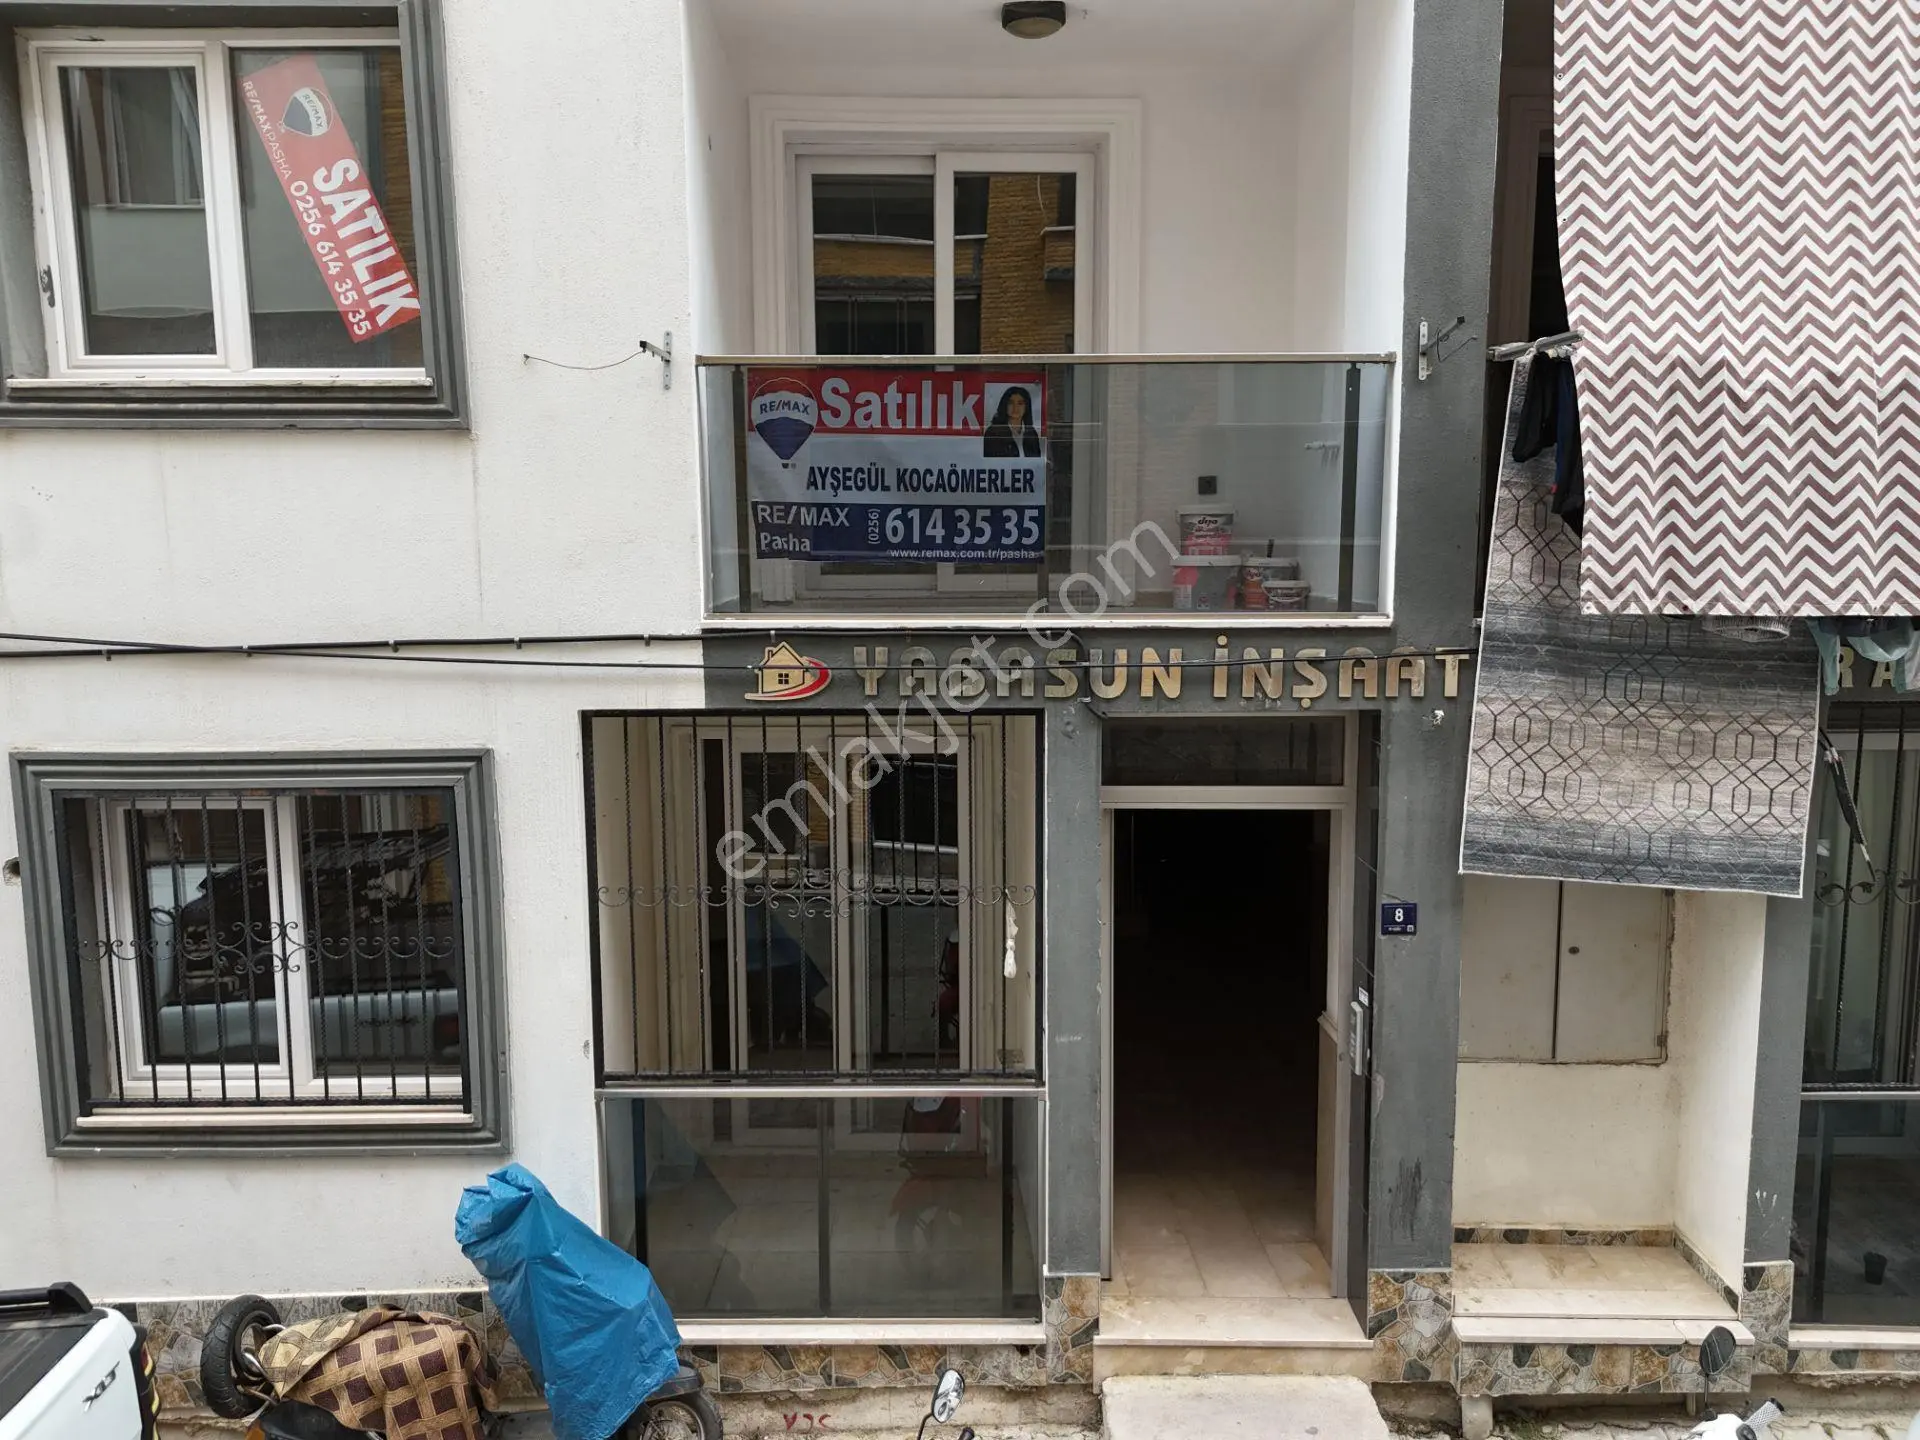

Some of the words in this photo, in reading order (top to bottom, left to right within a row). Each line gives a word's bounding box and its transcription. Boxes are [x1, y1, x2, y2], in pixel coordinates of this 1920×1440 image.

[290, 180, 327, 236] 0256
[316, 240, 345, 275] 614
[334, 278, 358, 306] 35
[347, 308, 372, 336] 35
[312, 158, 421, 328] SATILIK
[759, 398, 810, 416] RE/MAX
[820, 377, 982, 430] Satılık
[806, 462, 891, 497] AYŞEGÜL
[896, 463, 1035, 493] KOCAÖMERLER
[757, 504, 850, 527] RE/MAX
[867, 508, 881, 544] (0256)
[885, 507, 946, 545] 614
[953, 508, 993, 545] 35
[1001, 508, 1040, 545] 35
[760, 532, 811, 554] Pasha
[853, 646, 1184, 699] YABASUN
[1213, 634, 1470, 709] İNŞAAT
[1394, 908, 1404, 922] 8
